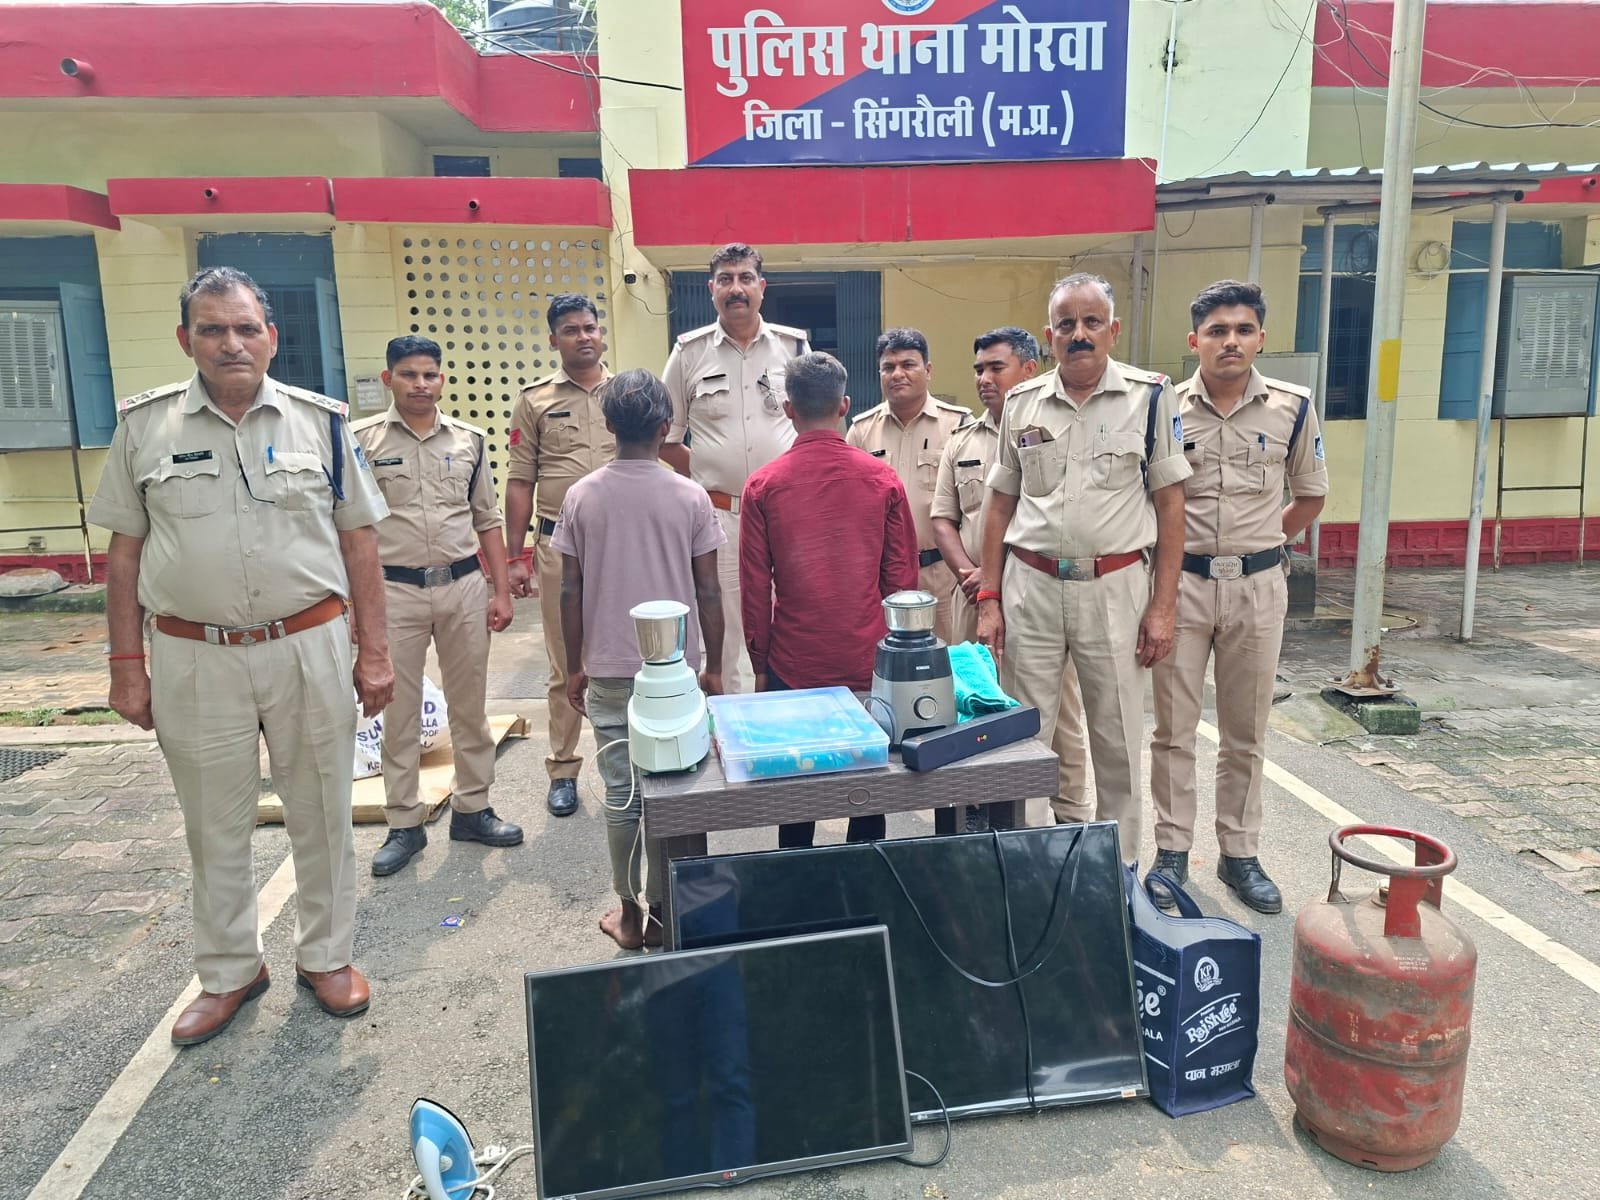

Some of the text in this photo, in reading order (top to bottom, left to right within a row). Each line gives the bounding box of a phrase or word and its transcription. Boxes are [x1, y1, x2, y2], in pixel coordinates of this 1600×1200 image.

[707, 5, 1107, 97] पुलिस थाना मोरवा
[743, 99, 823, 141] जिला
[853, 93, 974, 140] सिंगरौली
[982, 90, 1074, 147] (म.प्र.)
[1185, 1068, 1206, 1081] पान
